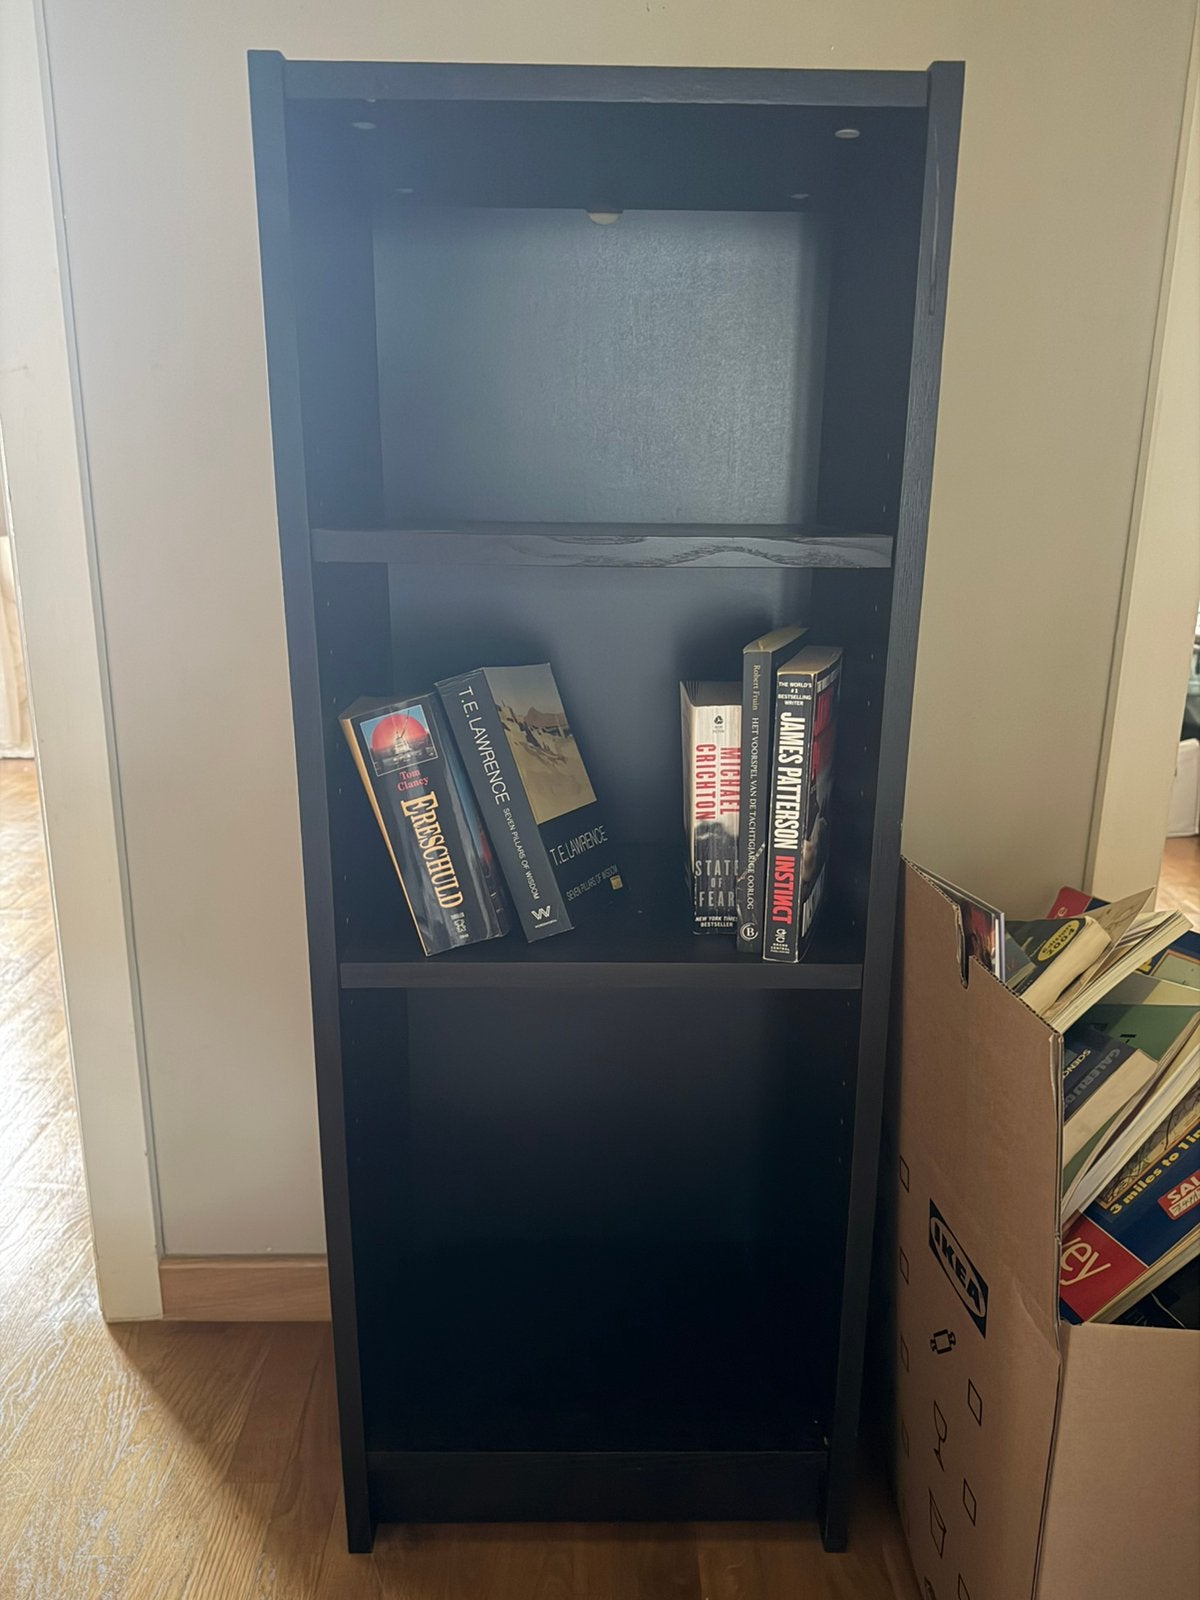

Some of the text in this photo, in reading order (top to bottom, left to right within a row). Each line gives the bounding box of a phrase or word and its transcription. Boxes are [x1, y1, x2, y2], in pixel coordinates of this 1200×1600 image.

[752, 690, 760, 711] Fruin
[752, 717, 760, 735] HET
[778, 712, 805, 764] JAMES
[468, 717, 511, 805] LAWRENCE
[750, 736, 759, 779] VOORSPEL
[397, 776, 429, 792] Clancy
[400, 769, 421, 780] Tom
[696, 744, 716, 820] CRICHTON
[720, 747, 741, 815] MICHAEL
[750, 779, 758, 797] VAN
[750, 799, 756, 809] DE
[774, 767, 802, 850] PATTERSON
[504, 808, 516, 831] SEVEN
[400, 791, 464, 908] ERESCHULD
[512, 831, 526, 860] PILLARS
[748, 810, 757, 874] TACHTIGJARIGE
[521, 859, 530, 870] OF
[695, 860, 738, 876] STATE
[525, 870, 540, 900] WISDOM
[566, 887, 582, 901] SEVEN
[580, 876, 597, 893] PILLARS
[710, 877, 722, 888] OF
[747, 874, 756, 910] OORLOG
[772, 855, 796, 924] INSTINCT
[699, 891, 735, 907] FEAR
[1049, 927, 1075, 955] 2004
[1110, 1203, 1122, 1214] 3
[1122, 1168, 1162, 1204] miles
[1162, 1152, 1180, 1167] to
[1178, 1142, 1190, 1150] 1
[934, 1221, 982, 1313] IKEA
